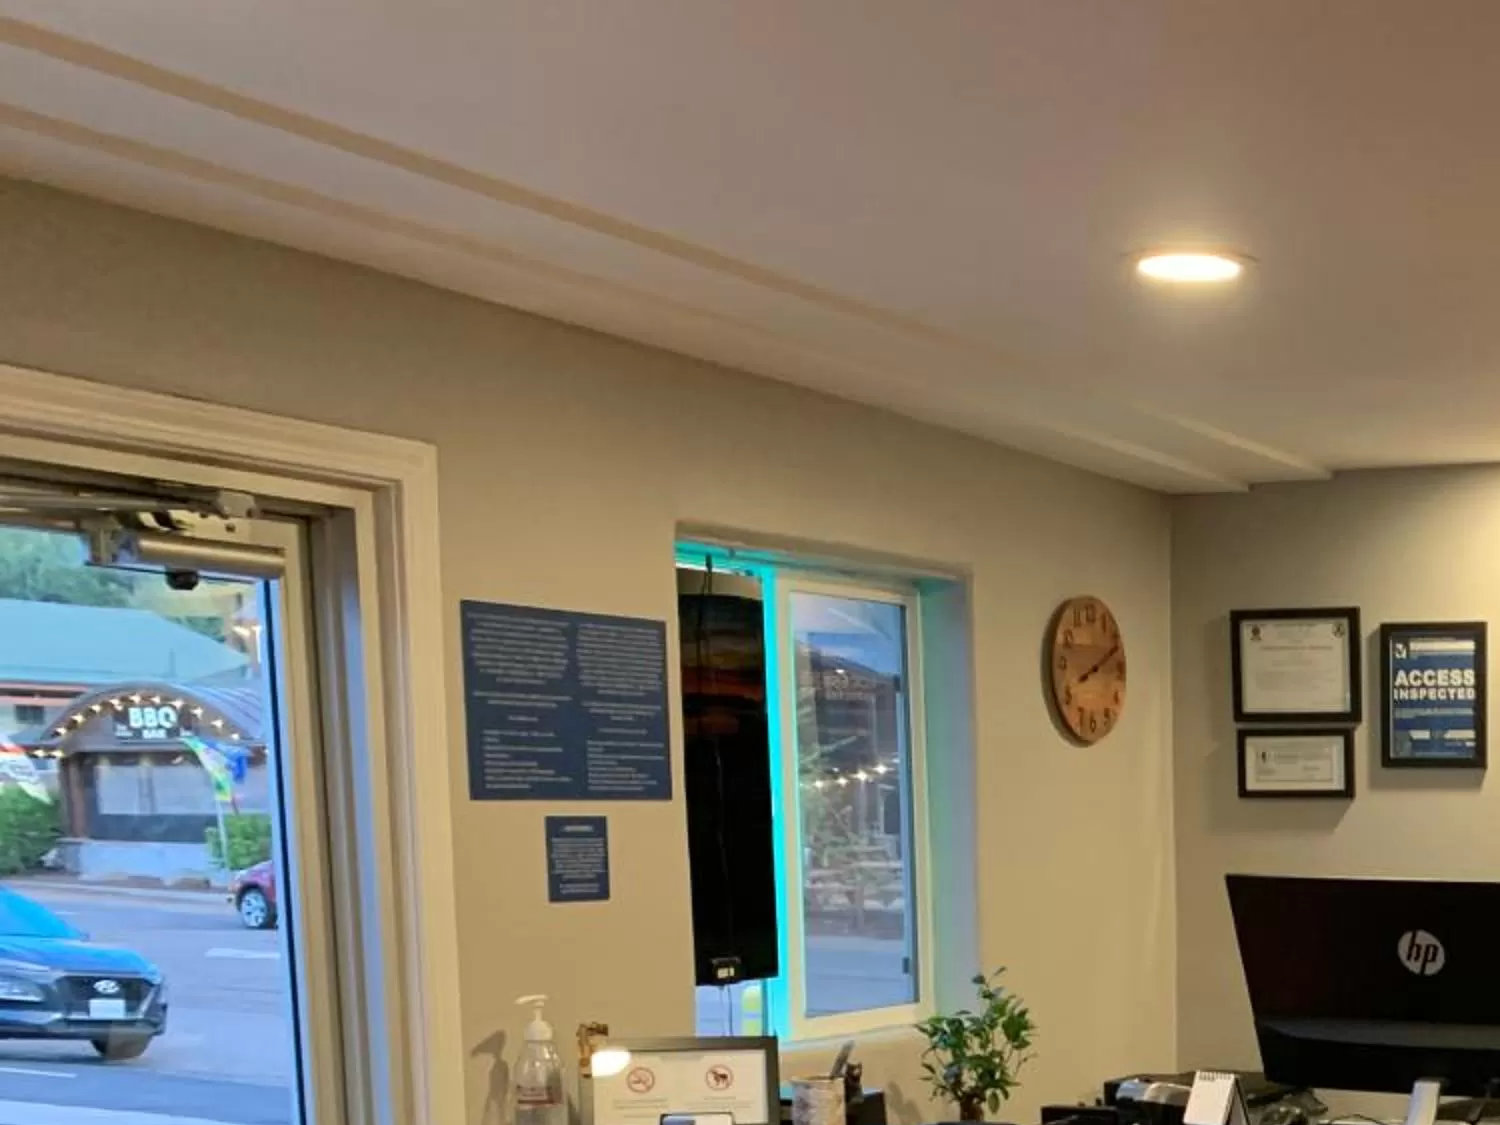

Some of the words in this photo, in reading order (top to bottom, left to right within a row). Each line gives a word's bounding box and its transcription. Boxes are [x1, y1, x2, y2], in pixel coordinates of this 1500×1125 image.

[1394, 669, 1475, 687] ACCESS
[1393, 687, 1475, 701] INSPECTED
[128, 706, 177, 729] BBQ
[1406, 930, 1439, 976] hp
